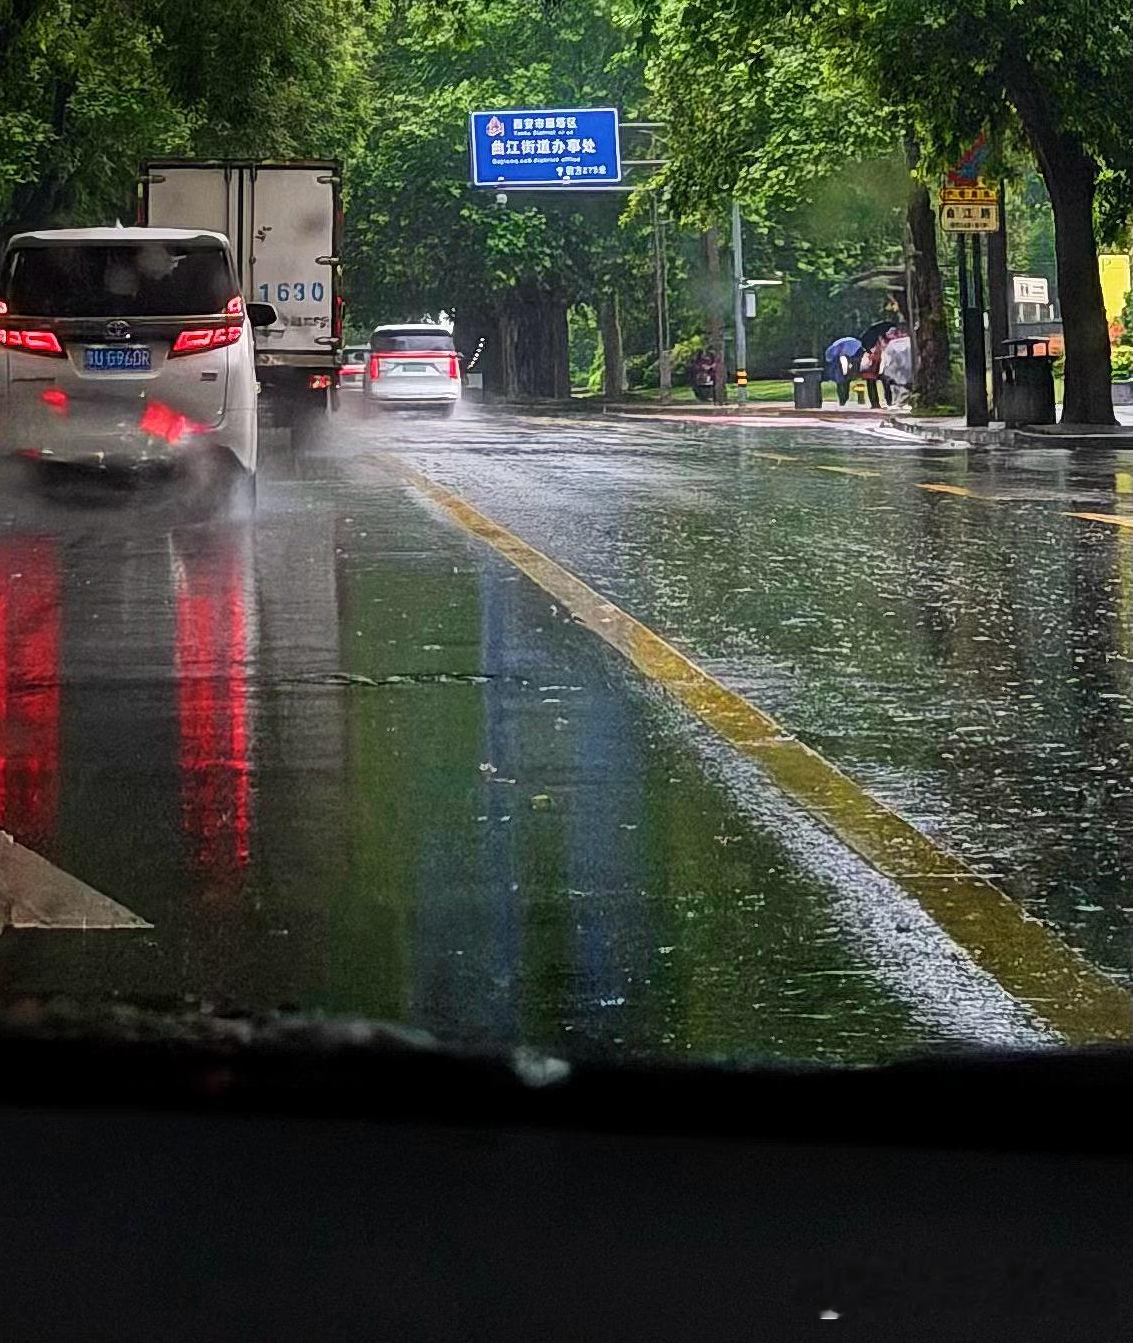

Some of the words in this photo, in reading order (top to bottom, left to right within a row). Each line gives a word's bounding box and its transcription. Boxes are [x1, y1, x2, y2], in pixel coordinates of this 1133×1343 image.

[491, 137, 596, 156] 曲江街道办事处
[259, 282, 324, 302] 1630
